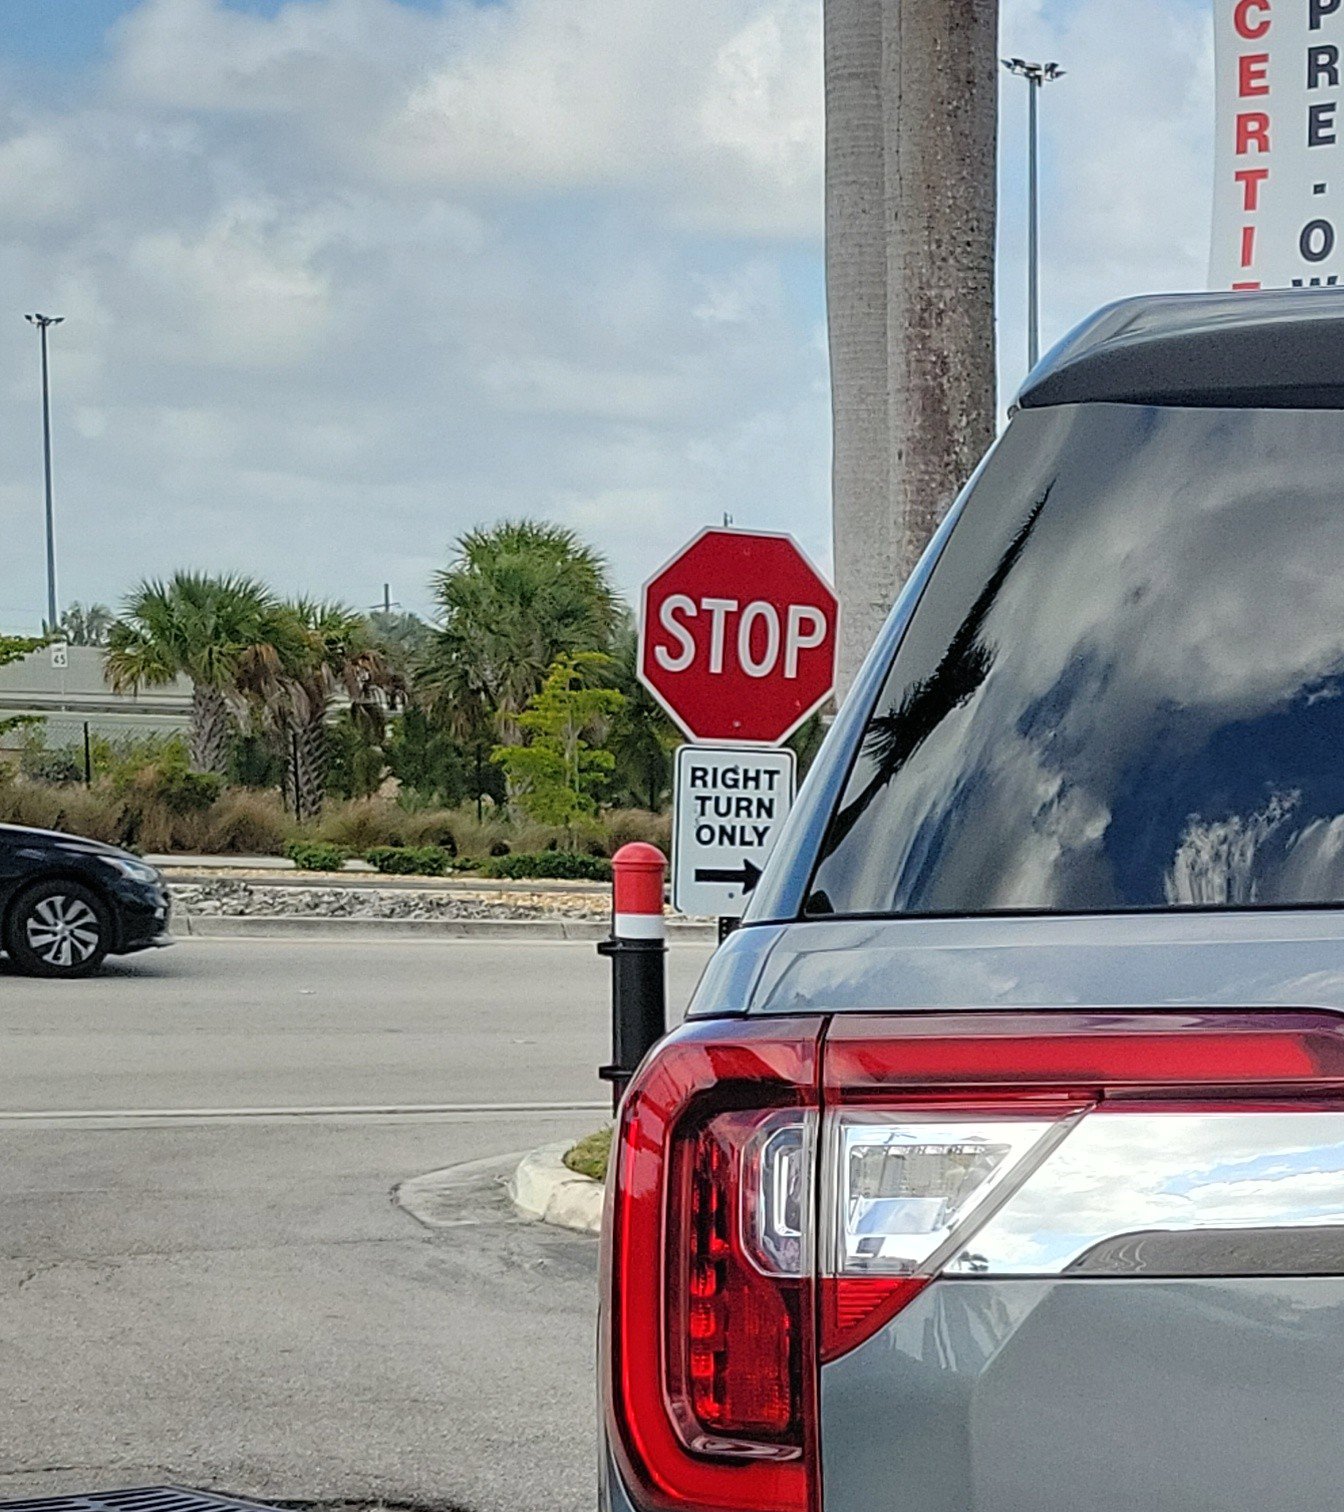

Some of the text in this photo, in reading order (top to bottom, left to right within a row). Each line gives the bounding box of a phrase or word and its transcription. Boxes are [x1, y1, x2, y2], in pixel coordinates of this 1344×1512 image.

[1231, 0, 1272, 290] CERTI
[1291, 0, 1342, 287] PRE-O
[654, 594, 828, 679] STOP
[690, 766, 780, 791] RIGHT
[694, 795, 775, 820] TURN
[695, 824, 771, 847] ONLY
